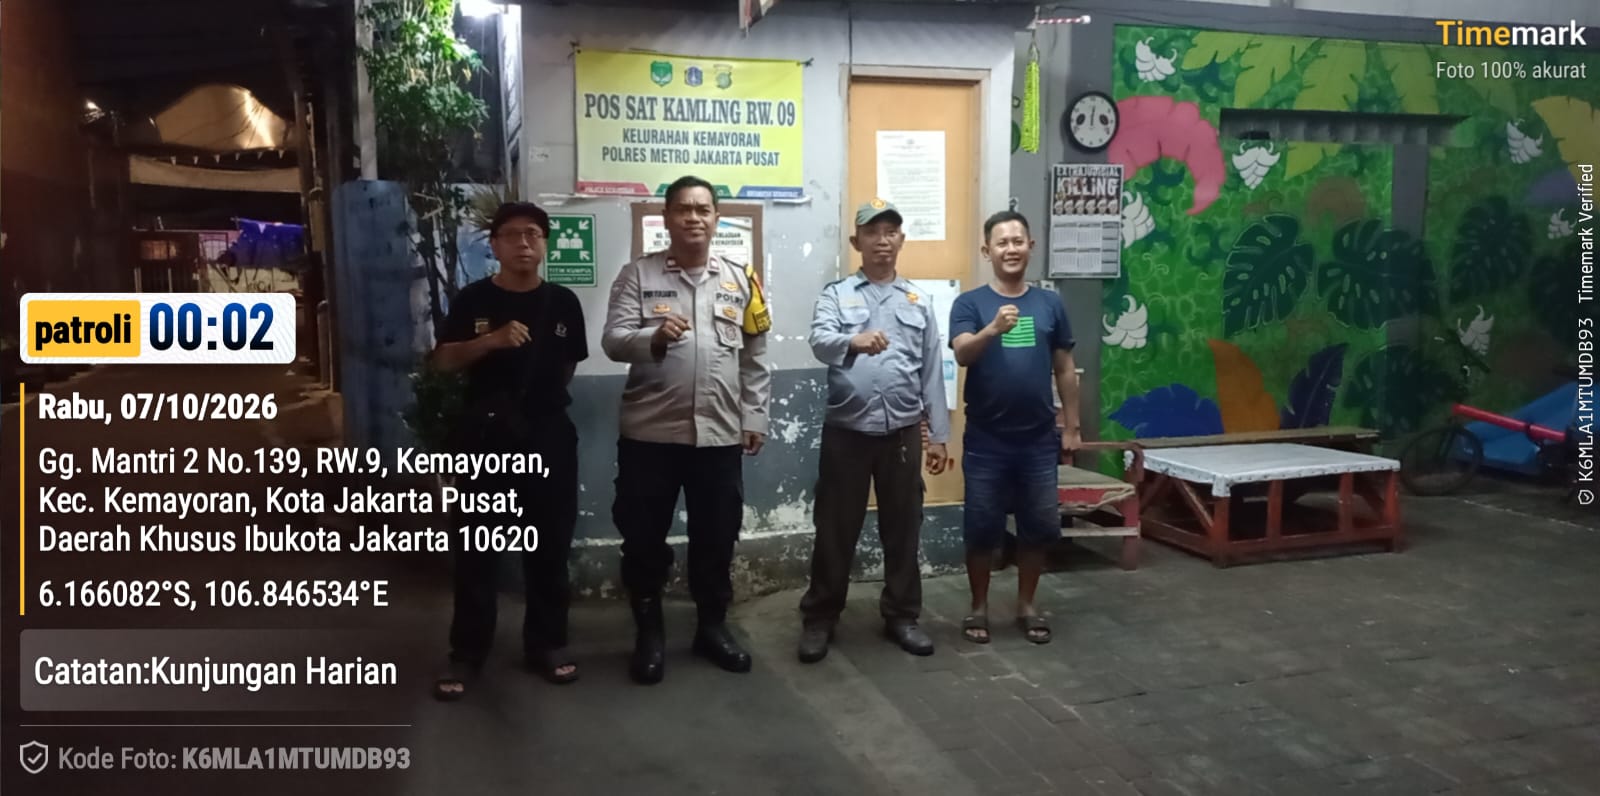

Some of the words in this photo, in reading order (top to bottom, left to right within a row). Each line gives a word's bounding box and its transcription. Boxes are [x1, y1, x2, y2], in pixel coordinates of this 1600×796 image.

[584, 93, 621, 120] POS
[626, 95, 658, 121] SAT
[662, 97, 741, 126] KAMLING
[746, 100, 773, 126] RW.
[777, 101, 796, 127] 09
[623, 128, 690, 146] KELURAHAN
[693, 130, 761, 147] KEMAYORAN
[602, 146, 647, 163] POLRES
[650, 148, 690, 164] METRO
[693, 150, 742, 166] JAKARTA
[746, 151, 780, 166] PUSAT
[715, 292, 744, 305] POLRI
